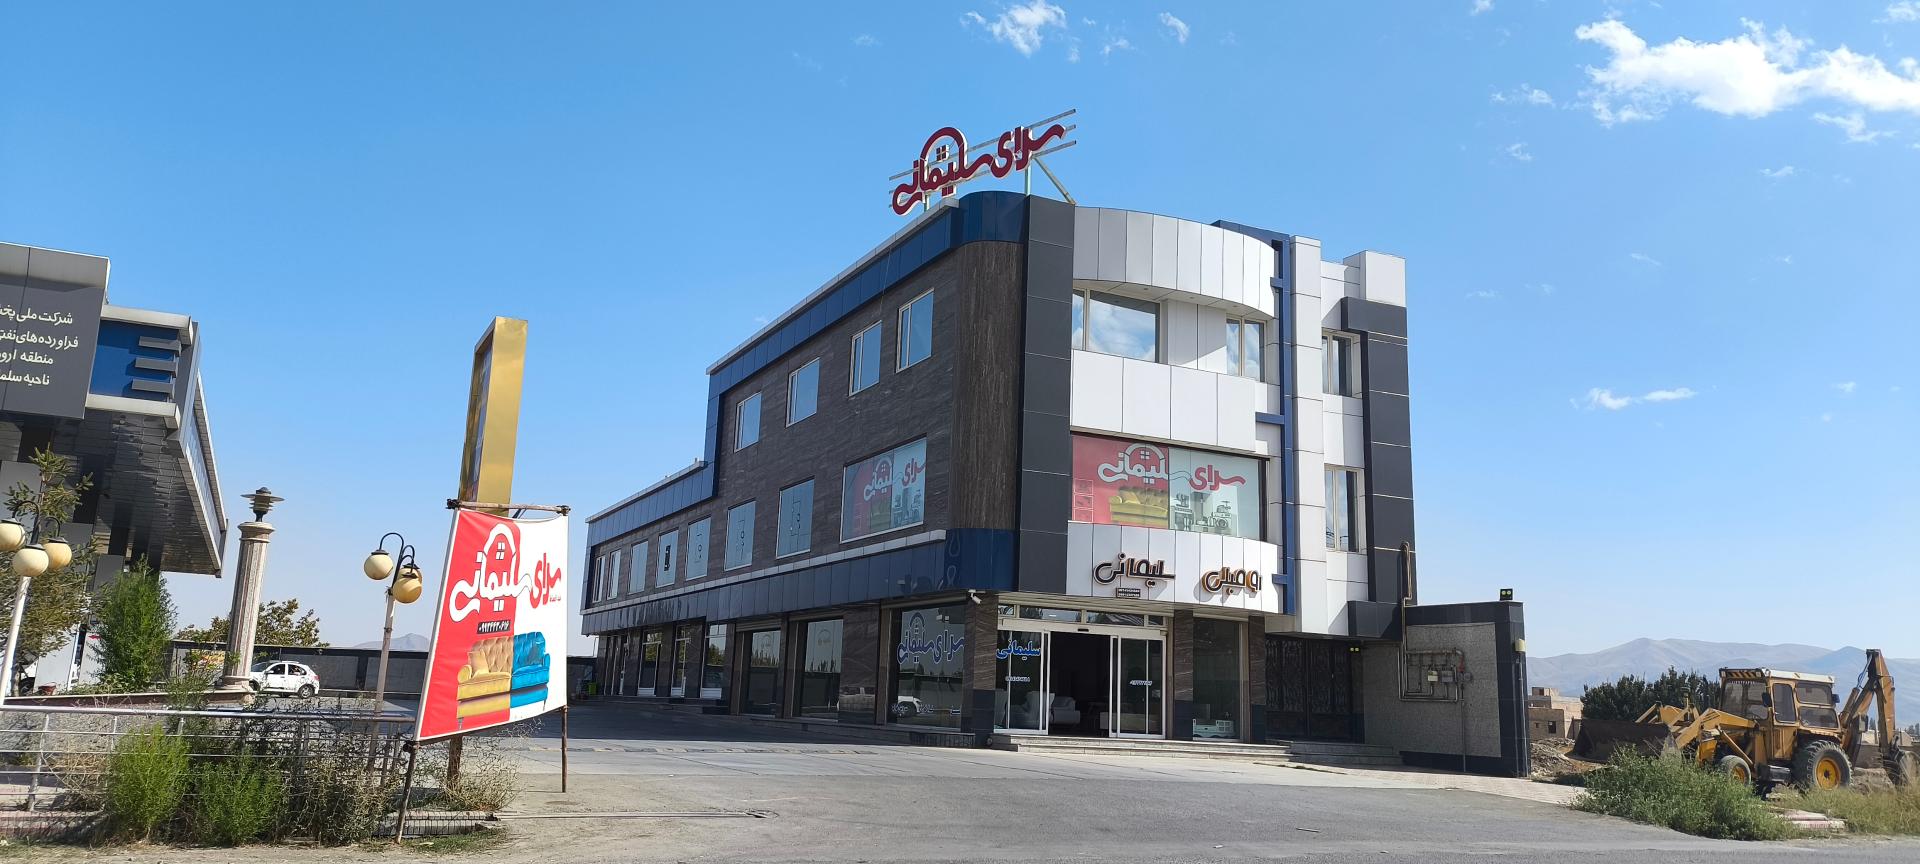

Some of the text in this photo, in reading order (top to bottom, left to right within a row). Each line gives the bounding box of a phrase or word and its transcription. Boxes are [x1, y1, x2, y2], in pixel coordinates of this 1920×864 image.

[892, 124, 1066, 216] سرای سلیمانی
[0, 304, 73, 326] شرکت ملی پخ
[0, 329, 16, 341] نفت
[0, 349, 54, 365] منطقه ارو
[0, 370, 50, 387] ناحیه سلم
[1097, 442, 1247, 492] سرای سلیمانی
[448, 523, 562, 623] سرای سلیمانی
[1093, 552, 1176, 588] سلیمانی
[995, 639, 1041, 661] سلیمانی
